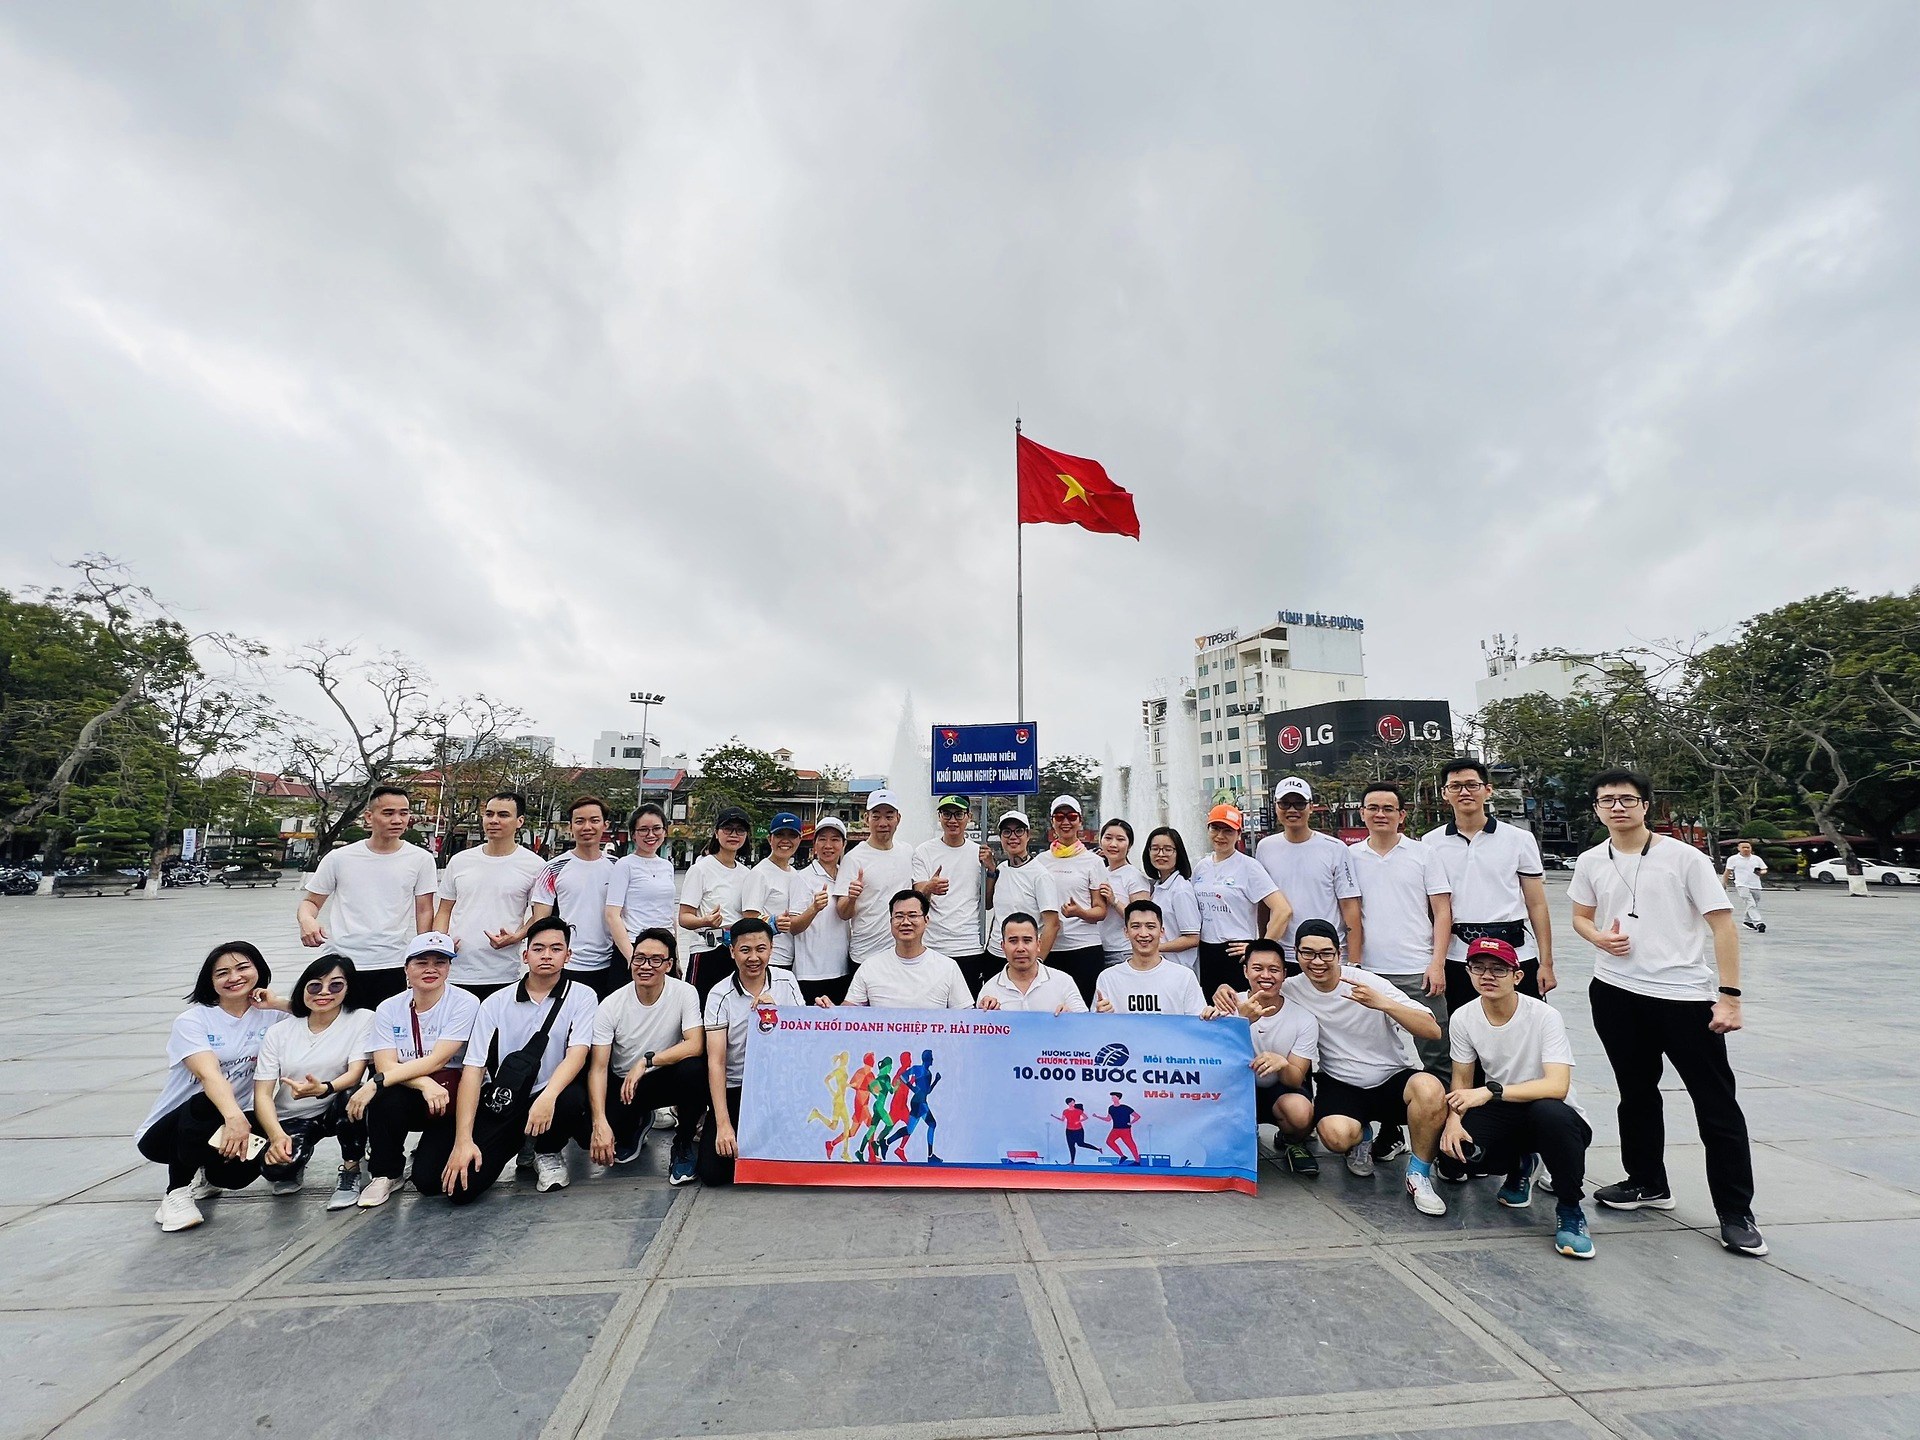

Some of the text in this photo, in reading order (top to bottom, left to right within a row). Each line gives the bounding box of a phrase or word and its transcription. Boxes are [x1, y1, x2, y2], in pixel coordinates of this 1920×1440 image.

[1305, 723, 1335, 747] LG
[1408, 720, 1442, 741] LG
[952, 751, 1017, 763] ĐOÀN THANH NIÊN
[936, 764, 1033, 784] KHỐI DOANH NGHIỆP THÀNH PHỐ
[1128, 994, 1162, 1012] COOL
[780, 1017, 1011, 1036] ĐOÀN KHỐI DOANH NGHIỆP TP. HẢI PHÒNG
[1166, 1056, 1196, 1065] thanh
[1198, 1057, 1222, 1065] niên
[1013, 1066, 1077, 1081] 10.000
